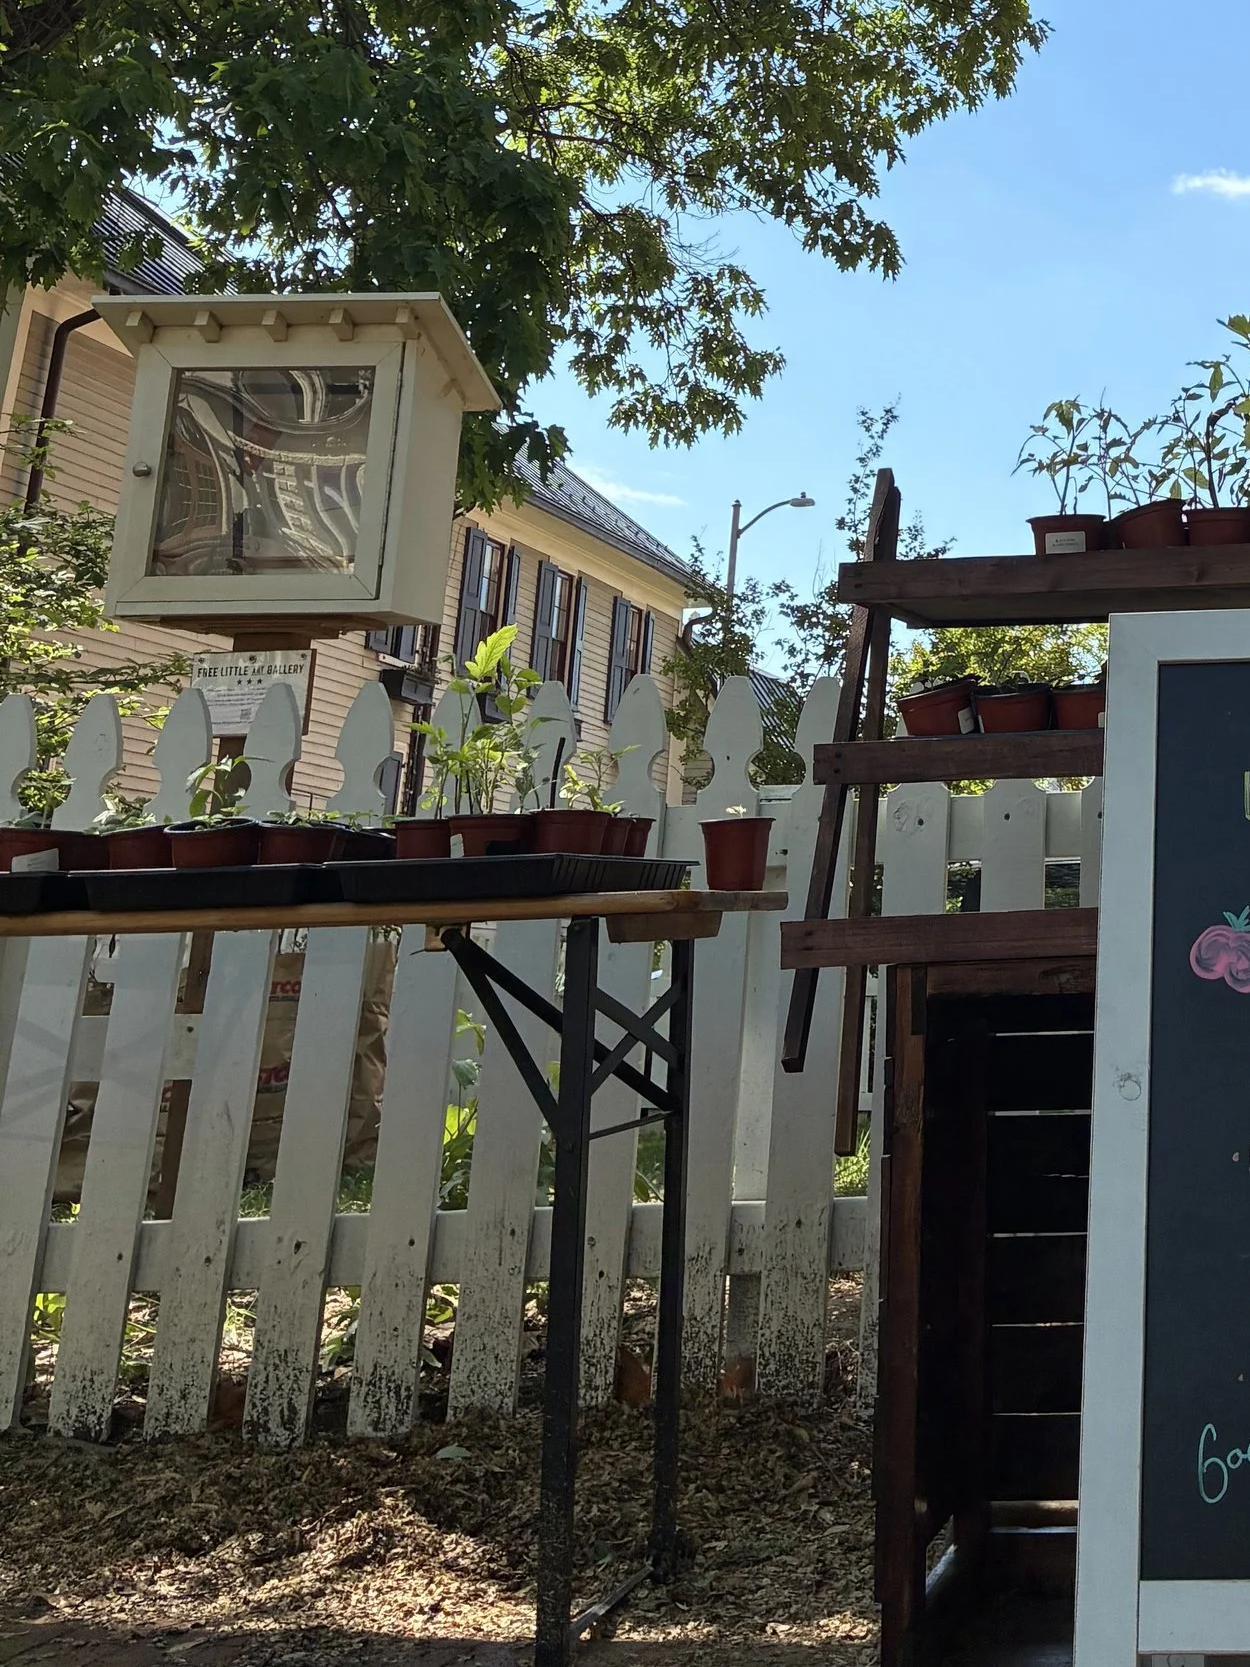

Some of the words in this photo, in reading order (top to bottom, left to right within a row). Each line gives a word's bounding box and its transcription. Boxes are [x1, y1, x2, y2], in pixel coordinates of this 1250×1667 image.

[197, 667, 219, 678] FREE
[220, 665, 249, 677] LITTLE
[266, 664, 305, 675] GALLERY
